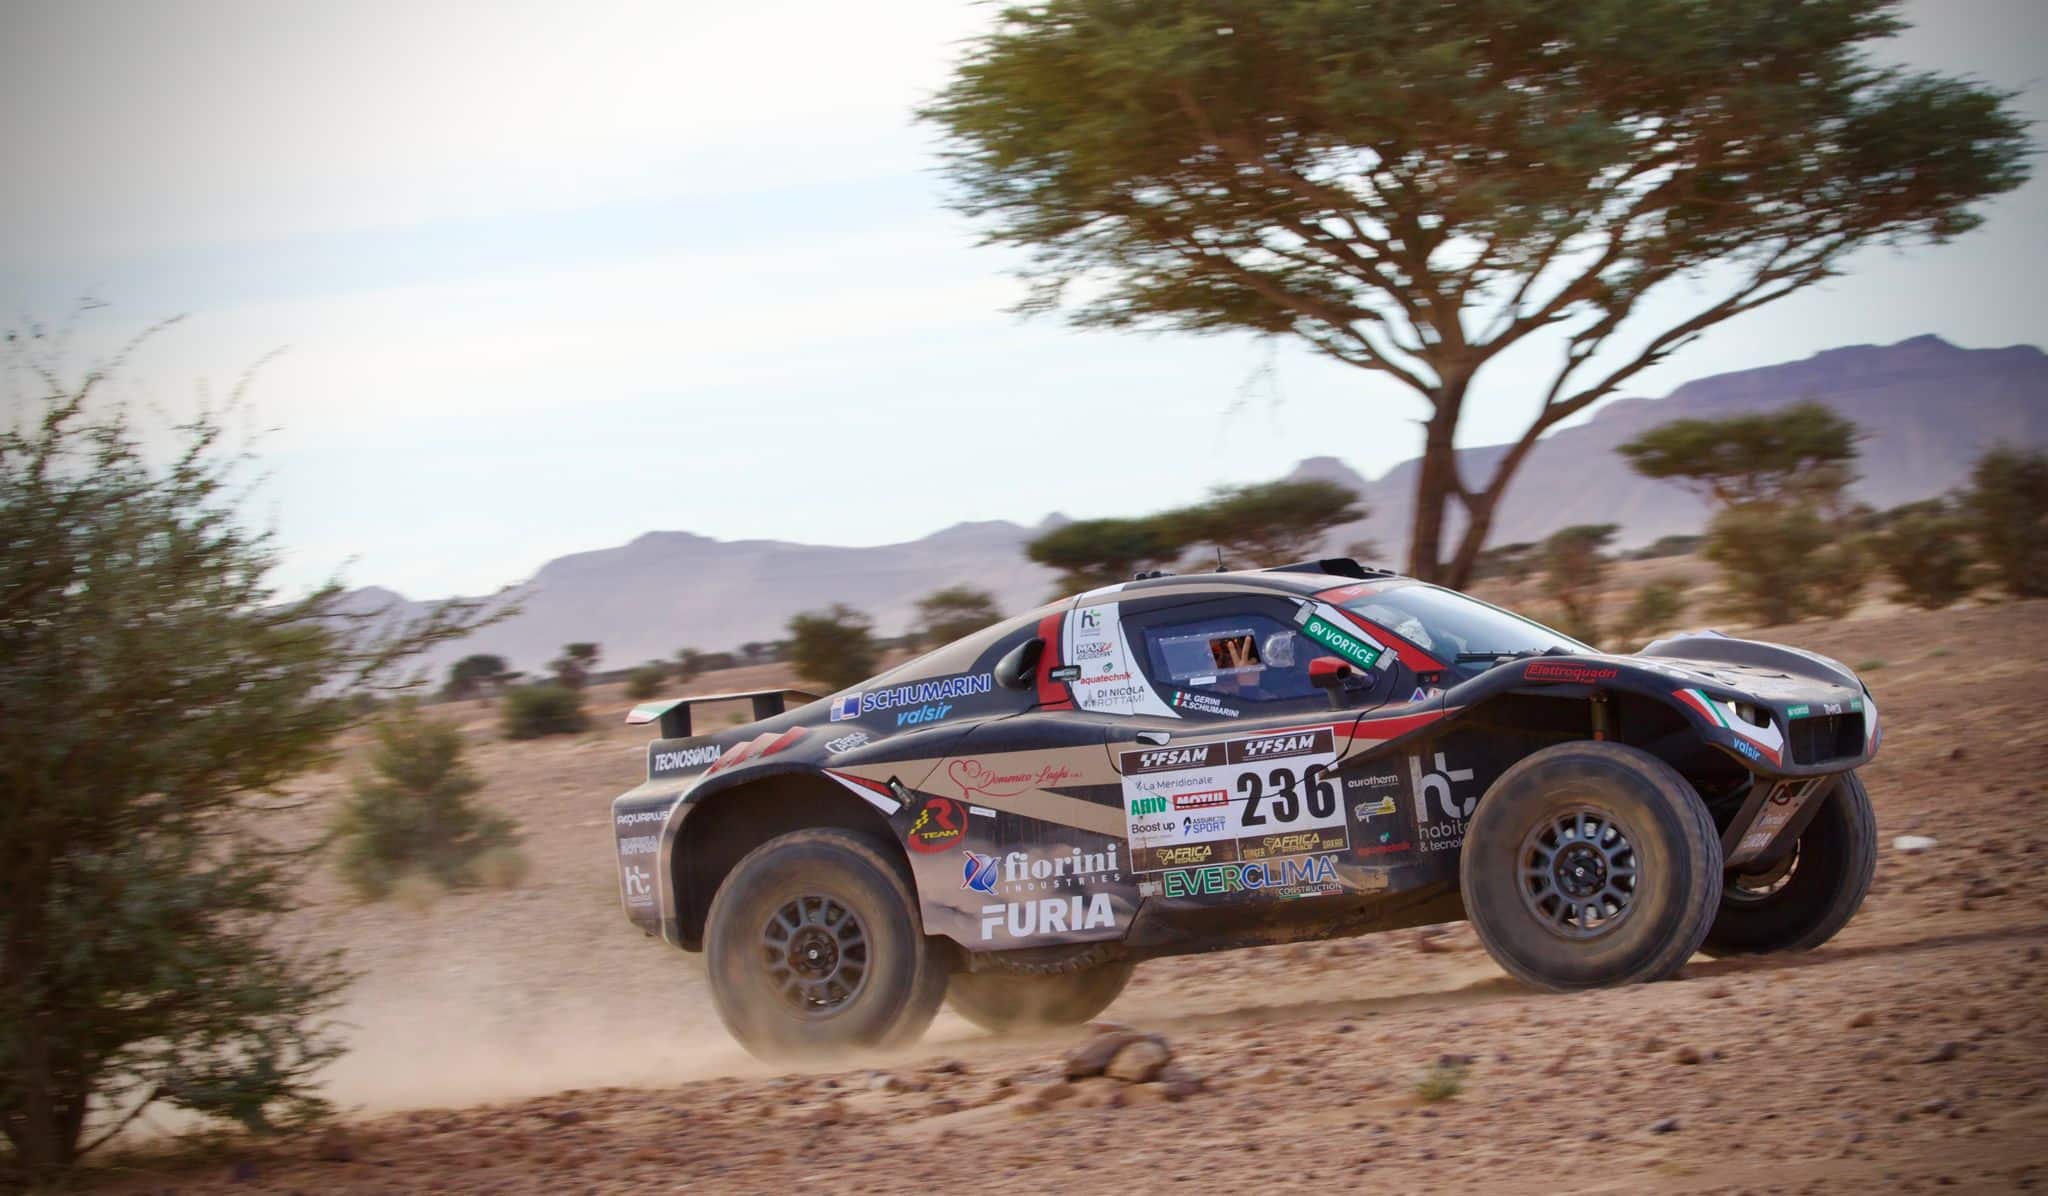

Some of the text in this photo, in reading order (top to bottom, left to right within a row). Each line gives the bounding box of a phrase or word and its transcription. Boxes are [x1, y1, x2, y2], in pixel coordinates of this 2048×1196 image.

[1326, 630, 1374, 663] VORTICE
[1080, 672, 1132, 685] aquatechnik
[862, 673, 992, 712] SCHIUMARINI
[1097, 686, 1144, 697] DI NICOLA
[1098, 695, 1144, 706] ROTTAMI
[1194, 695, 1221, 706] GERINI
[897, 702, 953, 727] valsir
[655, 744, 720, 771] TECNOSONDA
[1733, 738, 1761, 761] valsir
[1144, 783, 1155, 791] La
[1347, 774, 1399, 788] eurotherm
[1176, 791, 1224, 809] MOTUL
[1236, 763, 1336, 827] 236
[1131, 796, 1167, 816] AMV
[921, 829, 959, 839] TEAM
[1131, 822, 1176, 834] Boost up
[1193, 821, 1226, 834] SPORT
[1271, 832, 1320, 850] AFRICA
[1165, 845, 1212, 861] AFRICA
[1004, 843, 1120, 882] fiorini
[1005, 873, 1121, 893] INDUSTRIES
[1163, 855, 1339, 898] EVERCLIMA
[1278, 883, 1342, 896] CONSTRUCTION
[981, 893, 1116, 941] FURIA
